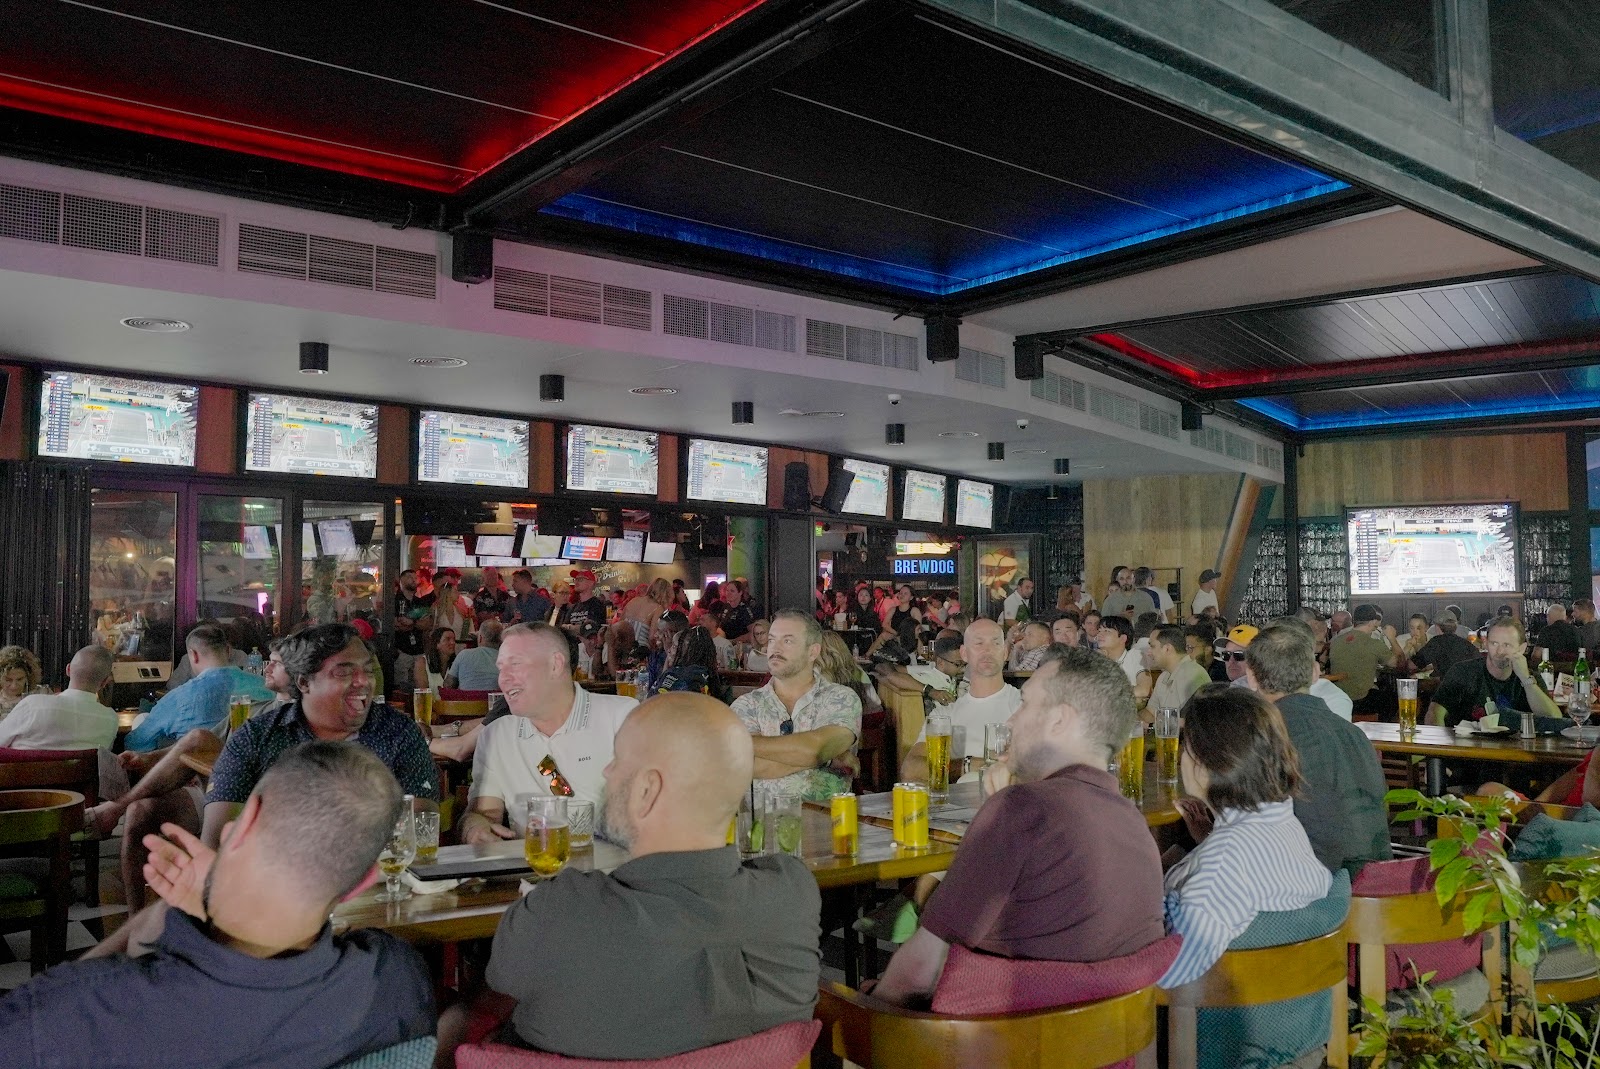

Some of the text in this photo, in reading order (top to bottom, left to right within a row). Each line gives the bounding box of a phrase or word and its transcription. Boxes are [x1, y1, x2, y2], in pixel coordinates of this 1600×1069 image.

[109, 445, 151, 455] ETIHAD
[305, 460, 340, 468] ETIHAD
[467, 471, 497, 479] ETIHAD
[894, 559, 955, 574] BREWDOG
[1421, 576, 1465, 585] ETIHAD
